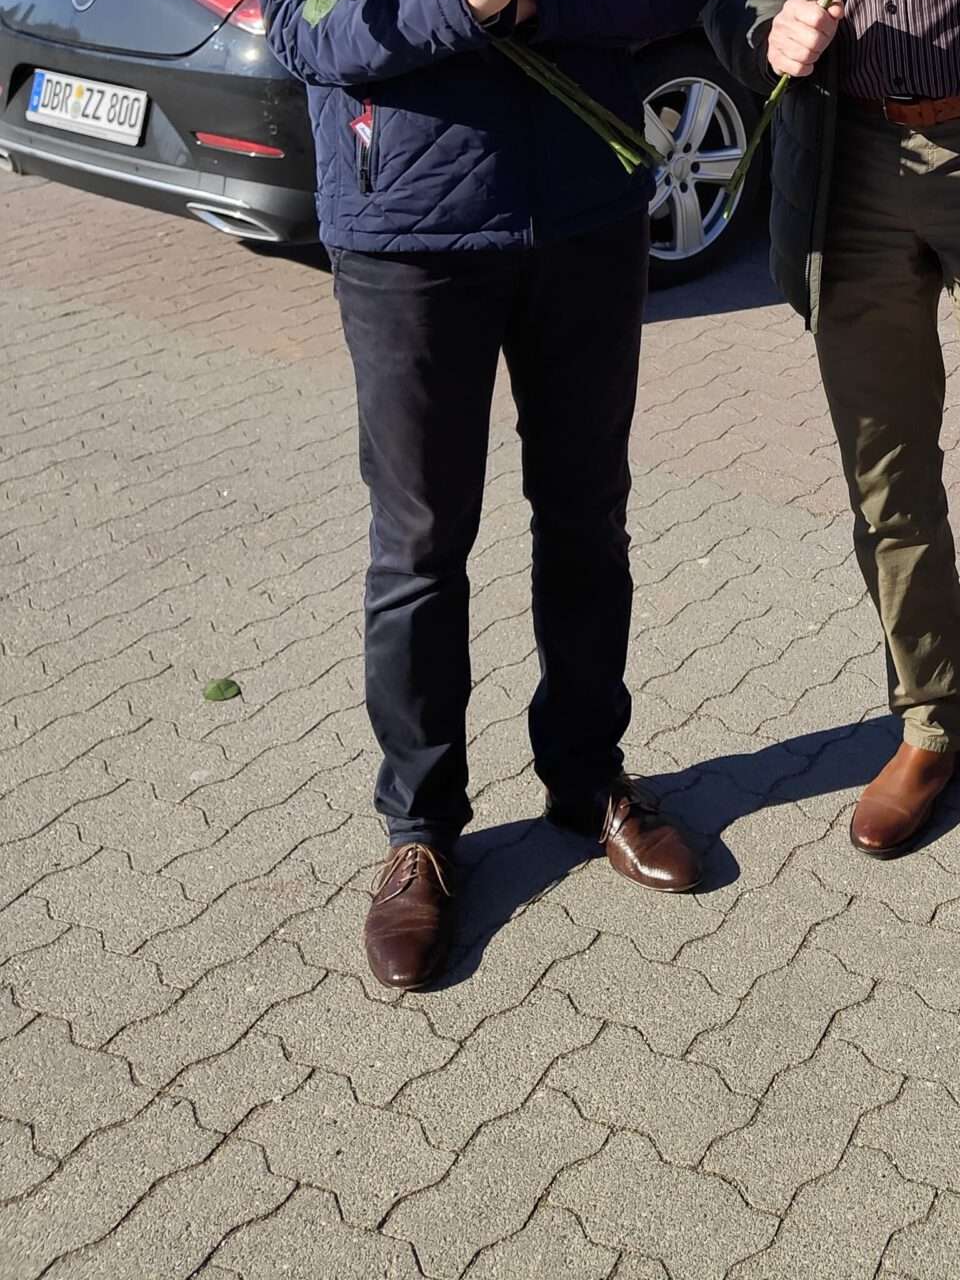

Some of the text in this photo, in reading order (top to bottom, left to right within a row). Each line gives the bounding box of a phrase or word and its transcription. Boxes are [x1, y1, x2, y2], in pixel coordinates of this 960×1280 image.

[41, 79, 141, 128] DBR ZZ 800
